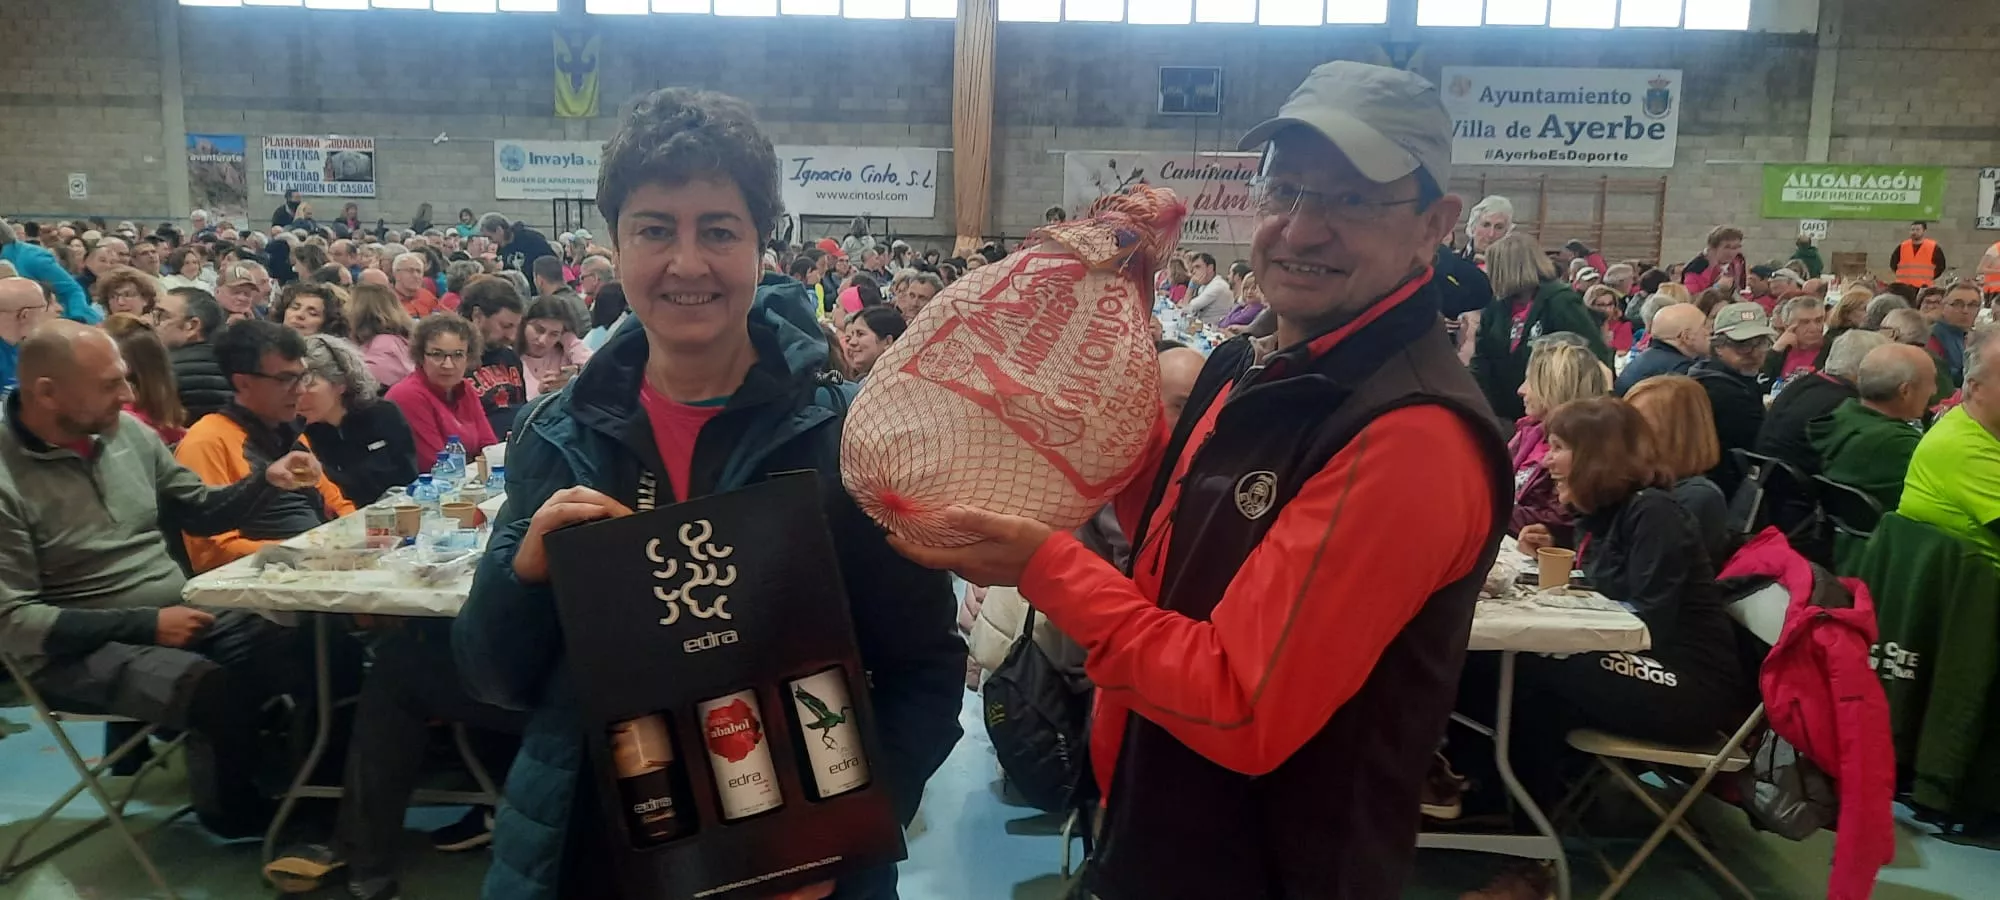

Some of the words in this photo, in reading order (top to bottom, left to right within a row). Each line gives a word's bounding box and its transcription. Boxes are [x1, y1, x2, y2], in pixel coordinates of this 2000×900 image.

[1478, 86, 1632, 107] Ayuntamiento
[1506, 120, 1531, 138] de
[1537, 114, 1665, 145] Ayerbe
[264, 136, 320, 149] PLATAFORMA
[326, 138, 372, 150] IUDADANA
[189, 153, 242, 162] aventúrate
[265, 149, 278, 161] EN
[280, 150, 320, 162] DEFENSA
[529, 152, 584, 168] Invayla
[1485, 150, 1628, 162] #AyerbeEsDeporte
[281, 161, 291, 170] DE
[295, 161, 306, 170] LA
[789, 157, 852, 187] Ignacio
[860, 163, 900, 187] Cinto,
[266, 171, 320, 182] PROPIEDAD
[501, 176, 536, 184] ALQUILER
[1784, 171, 1923, 190] ALTOARAGÓN
[266, 181, 278, 192] DE
[280, 182, 292, 192] LA
[293, 183, 325, 193] VIRGEN
[328, 183, 338, 194] DE
[340, 183, 374, 194] CASBAS
[816, 190, 908, 201] www.cintosl.com
[1796, 190, 1906, 202] SUPERMERCADOS
[1009, 286, 1079, 375] JAMONES
[1044, 372, 1101, 416] CASA
[683, 629, 740, 654] edra
[1600, 657, 1678, 687] adidas
[711, 718, 750, 738] ababol
[829, 757, 860, 775] edra
[728, 771, 762, 788] edra
